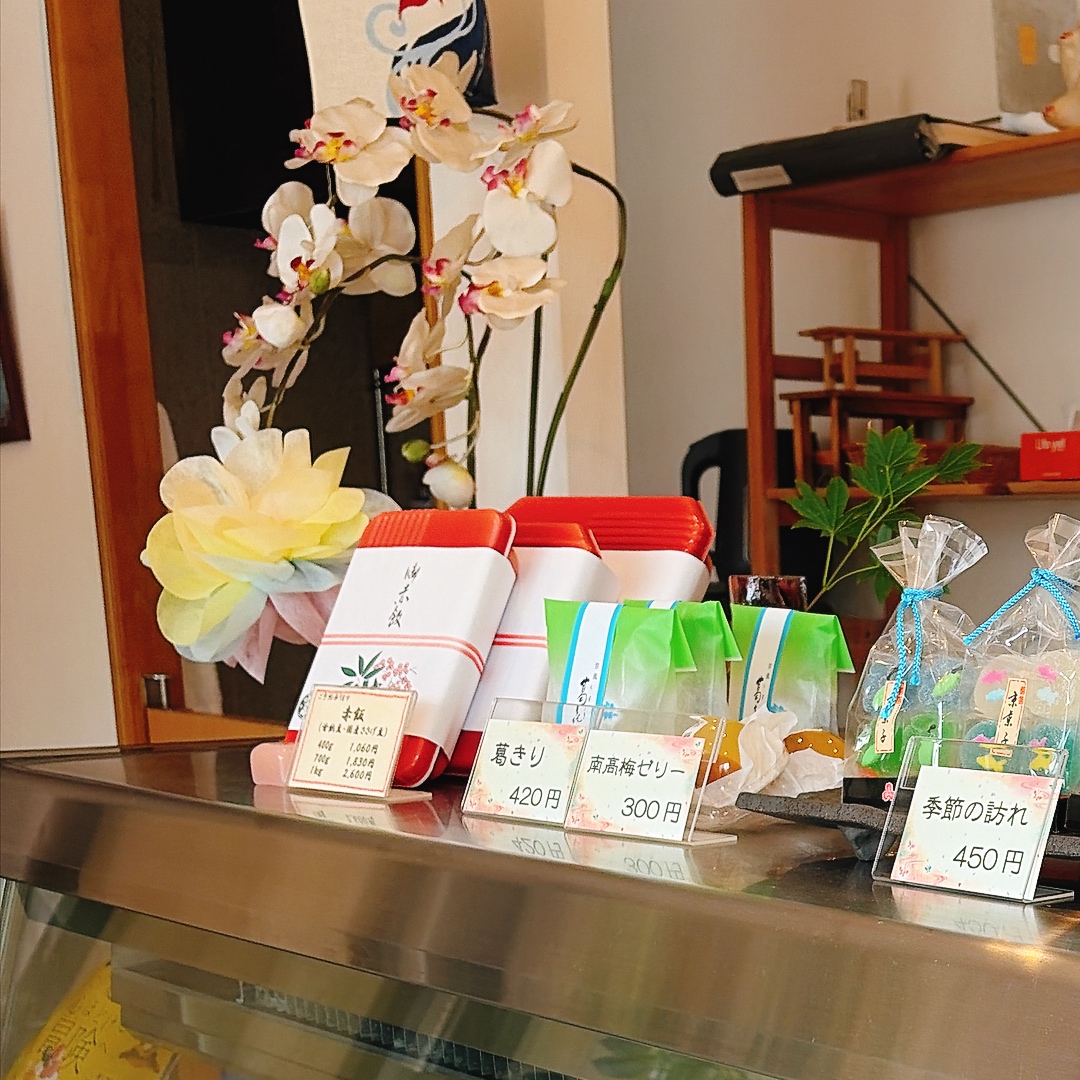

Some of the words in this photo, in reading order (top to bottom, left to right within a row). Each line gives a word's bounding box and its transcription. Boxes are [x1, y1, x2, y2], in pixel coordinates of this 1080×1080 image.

[341, 704, 366, 722] 赤飯
[317, 740, 334, 752] 400g
[349, 742, 379, 754] 1,060円
[490, 742, 545, 768] 葛きり
[313, 753, 331, 765] 700g
[346, 756, 375, 768] 1,830円
[310, 765, 324, 777] 1kg
[342, 769, 373, 781] 2,600円
[509, 786, 562, 810] 420円
[621, 797, 683, 824] 300円
[922, 796, 1029, 826] 季節の訪れ
[953, 846, 1024, 875] 450円
